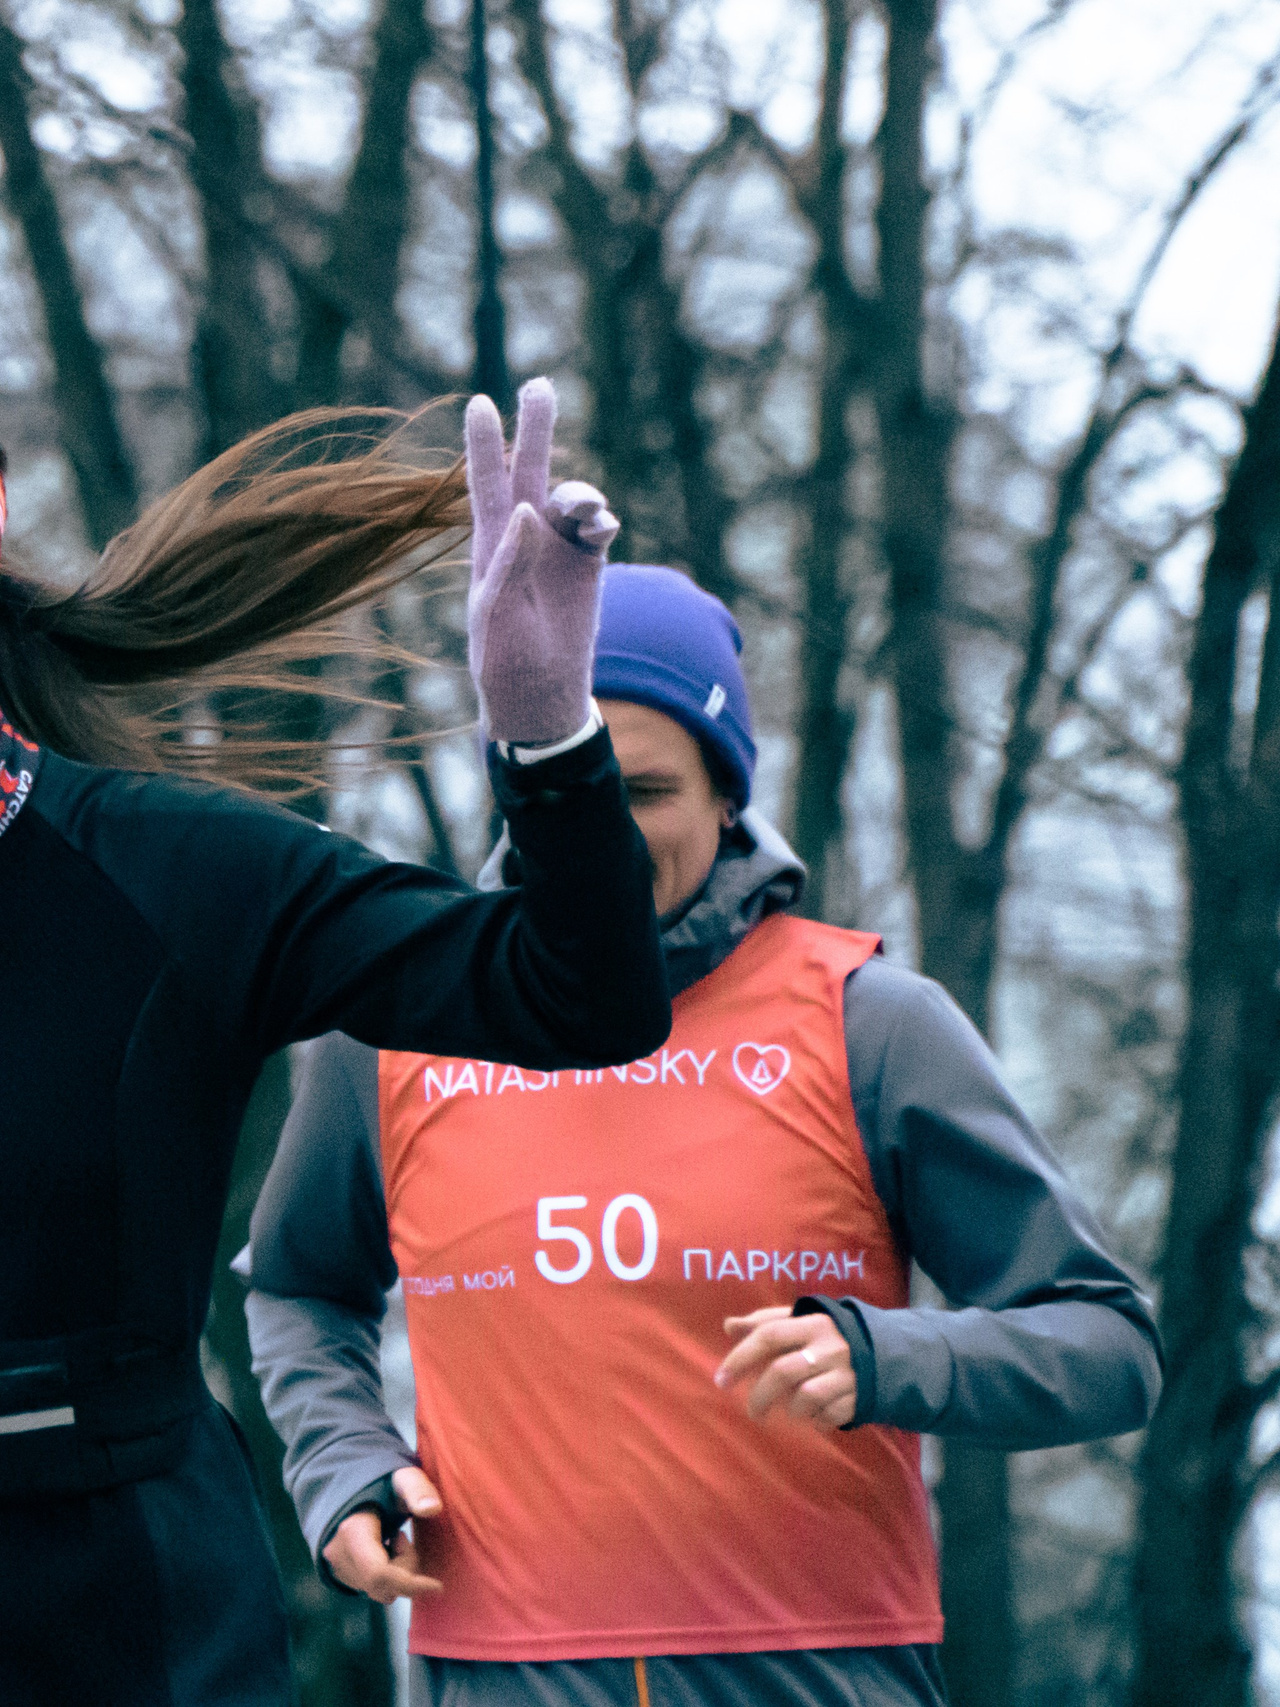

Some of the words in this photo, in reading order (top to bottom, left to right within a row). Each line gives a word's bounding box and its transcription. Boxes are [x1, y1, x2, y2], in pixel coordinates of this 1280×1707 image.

[463, 1265, 515, 1290] МОЙ
[534, 1193, 658, 1284] 50
[683, 1249, 865, 1281] ПАРКРАН
